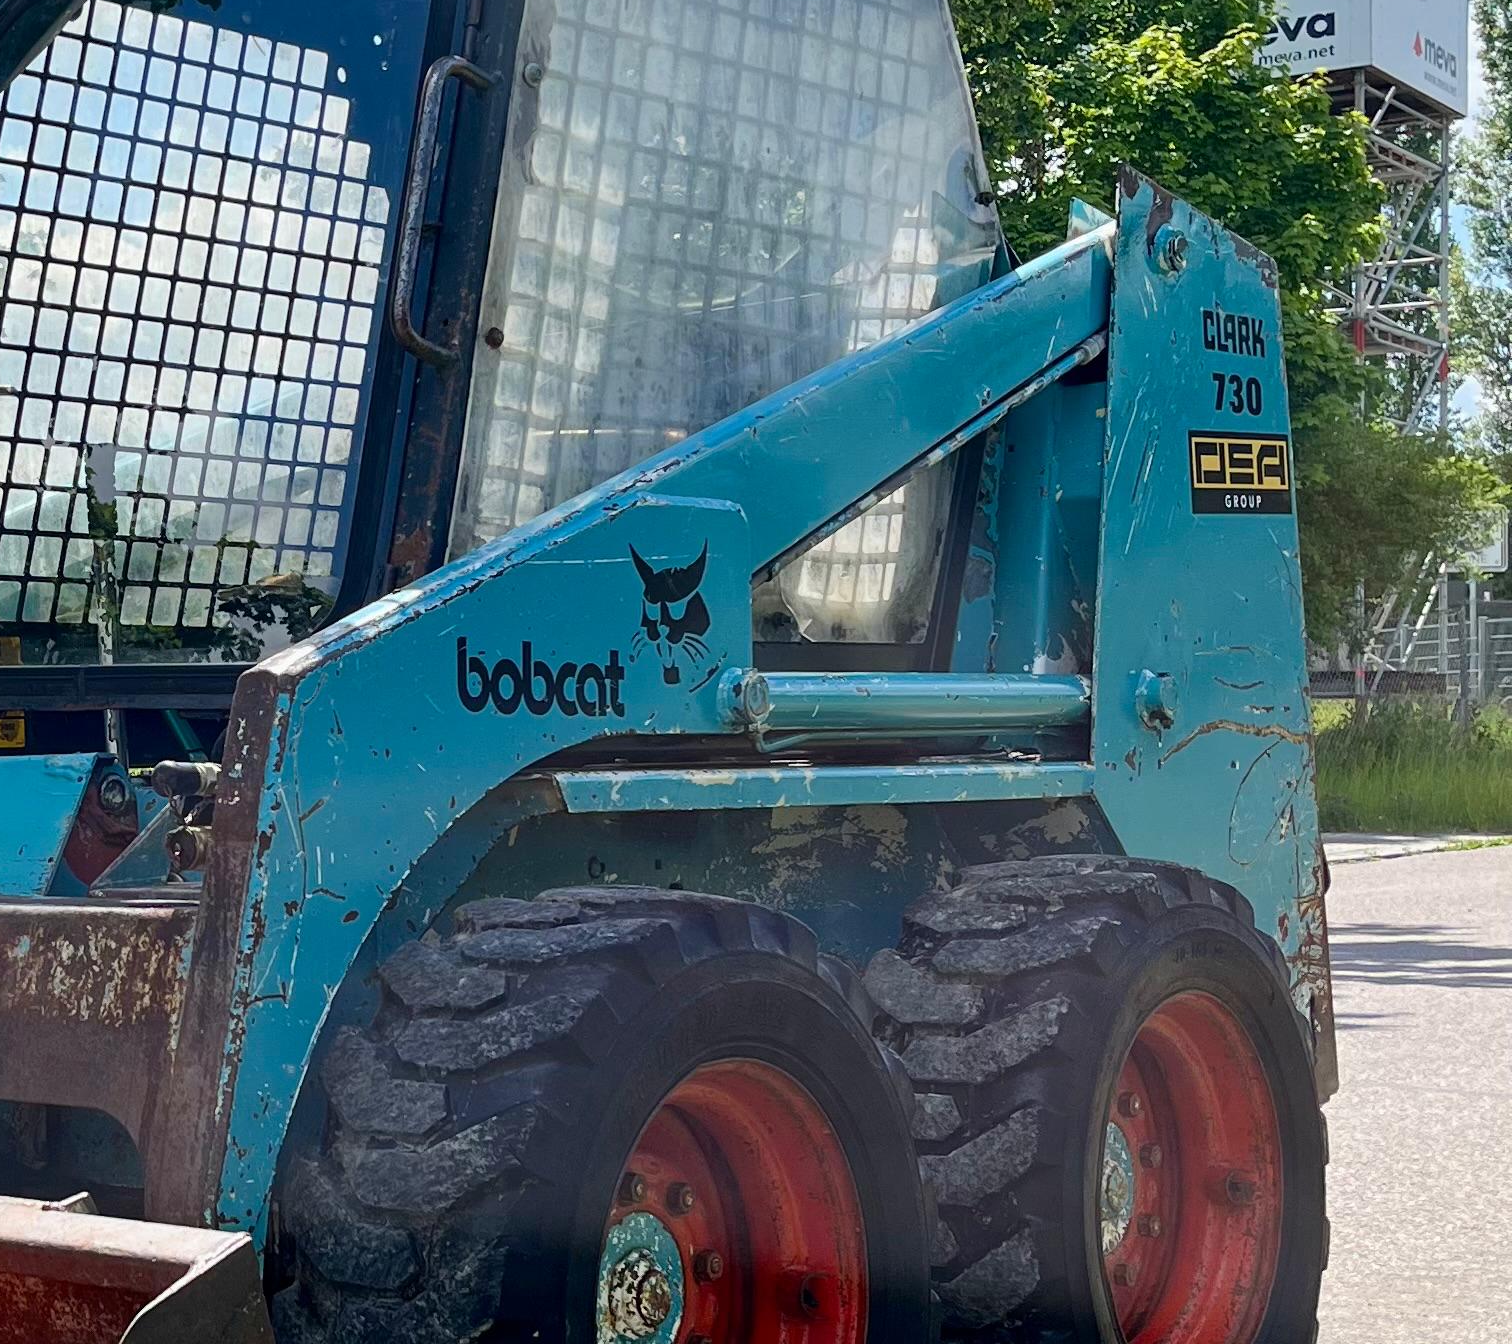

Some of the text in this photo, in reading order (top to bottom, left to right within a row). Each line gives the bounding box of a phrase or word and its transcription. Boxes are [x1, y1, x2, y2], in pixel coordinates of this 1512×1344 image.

[1262, 12, 1335, 46] eva
[1424, 37, 1457, 78] meva
[1202, 309, 1265, 358] CLARK
[1212, 372, 1262, 416] 730
[1224, 494, 1262, 509] GROUP
[456, 636, 625, 718] bobcat
